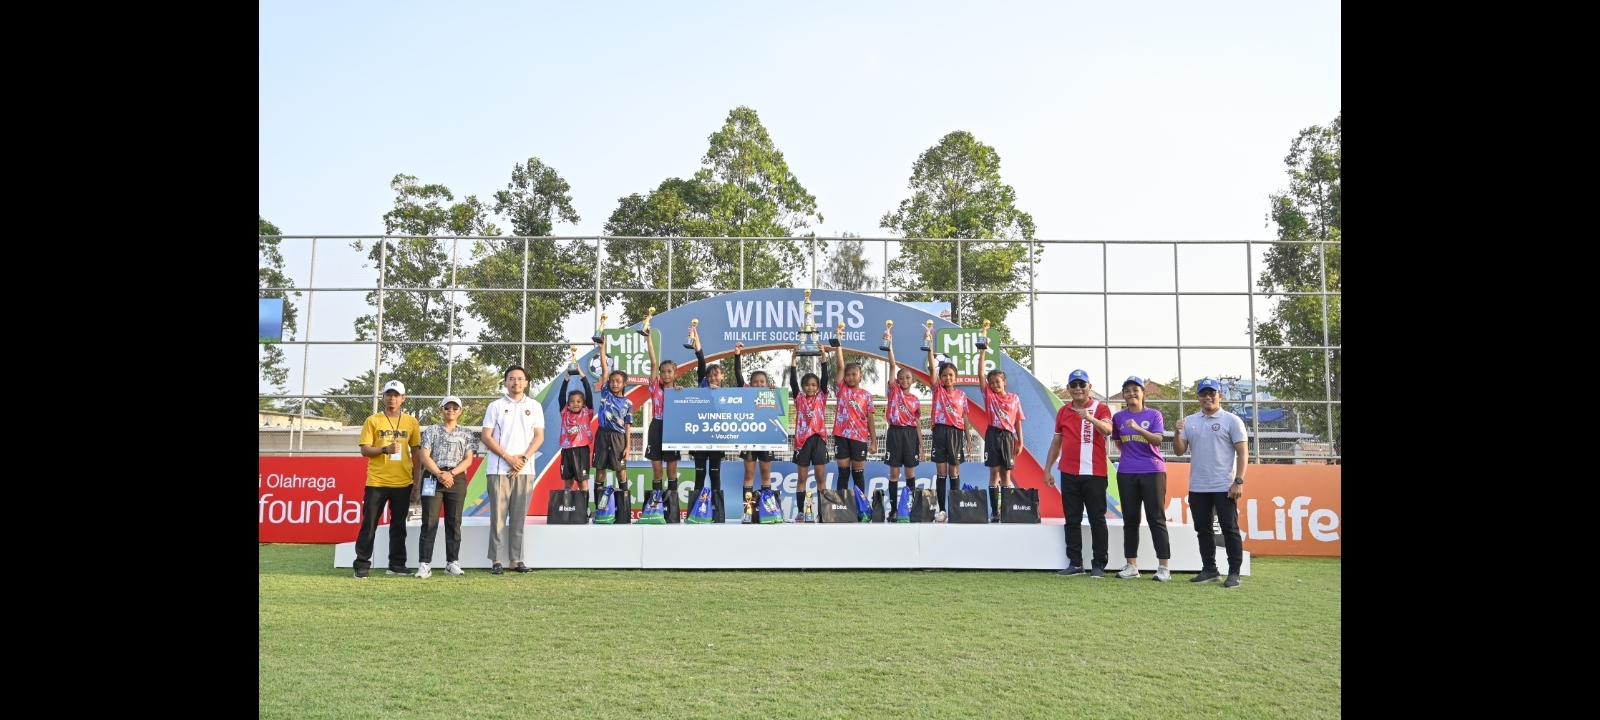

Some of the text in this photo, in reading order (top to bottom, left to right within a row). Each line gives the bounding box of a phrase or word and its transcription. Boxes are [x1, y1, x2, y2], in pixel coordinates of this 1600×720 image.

[725, 300, 865, 328] WINNERS
[724, 332, 767, 341] MILKLIFE
[770, 331, 802, 341] SOCCE
[727, 396, 743, 404] BCA
[697, 412, 755, 421] WINNER KU12
[685, 421, 767, 434] Rp 3.600.000
[266, 473, 336, 492] Olahraga
